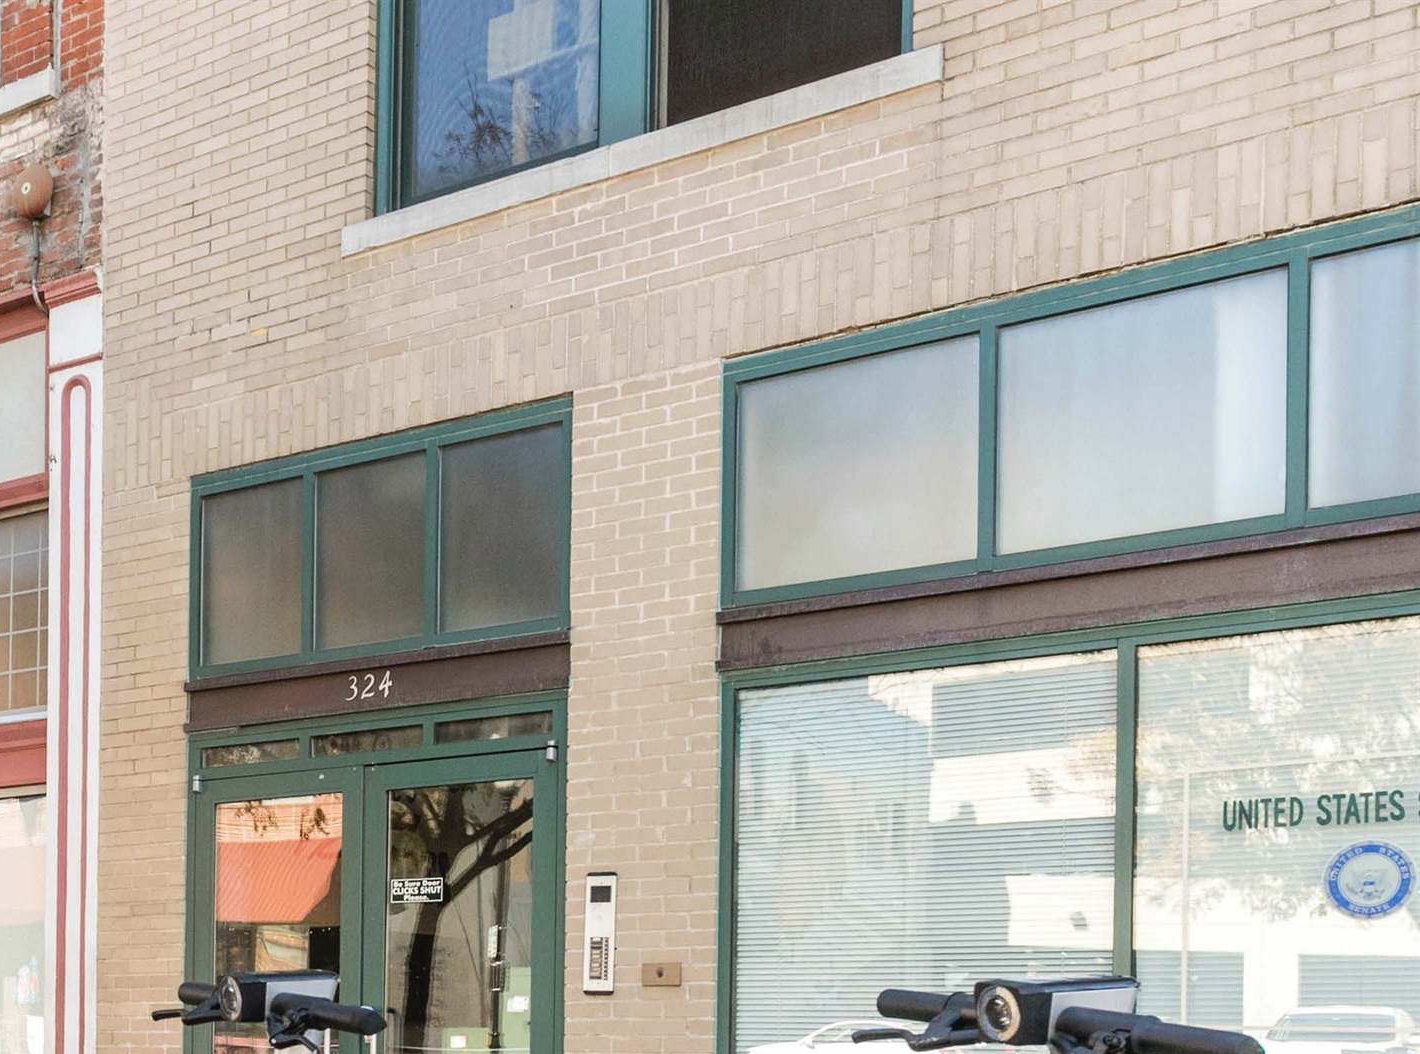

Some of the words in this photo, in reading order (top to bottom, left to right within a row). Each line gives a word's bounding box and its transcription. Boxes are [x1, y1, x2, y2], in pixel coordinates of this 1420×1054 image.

[344, 670, 393, 701] 324
[1222, 796, 1304, 832] UNITED
[1315, 789, 1406, 826] STATES
[1330, 846, 1363, 881] UNITED
[392, 887, 419, 895] CLICKS
[420, 885, 441, 895] SHUT
